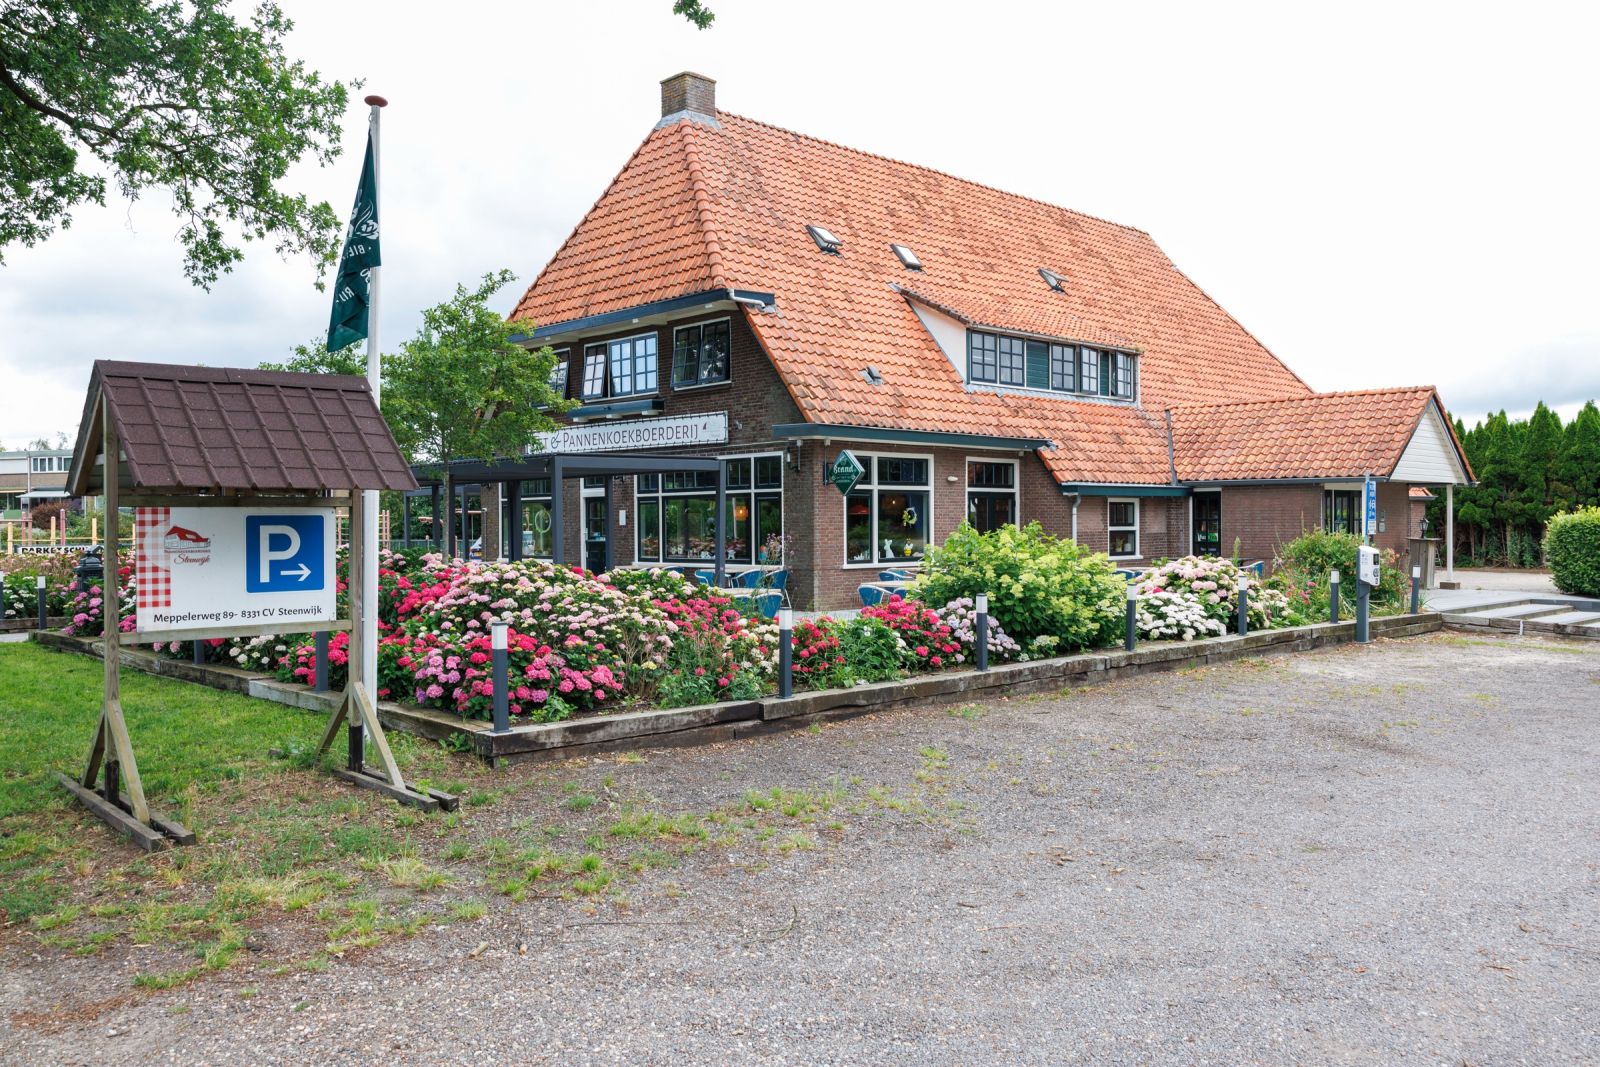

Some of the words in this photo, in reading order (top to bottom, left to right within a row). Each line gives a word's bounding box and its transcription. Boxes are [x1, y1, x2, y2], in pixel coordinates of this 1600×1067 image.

[563, 424, 698, 449] PANNENKOEKBOERDERIJ
[259, 524, 301, 583] P
[153, 611, 221, 624] Meppelerweg
[240, 610, 260, 619] 8331
[262, 608, 275, 617] CV
[278, 606, 322, 617] Steenwijk
